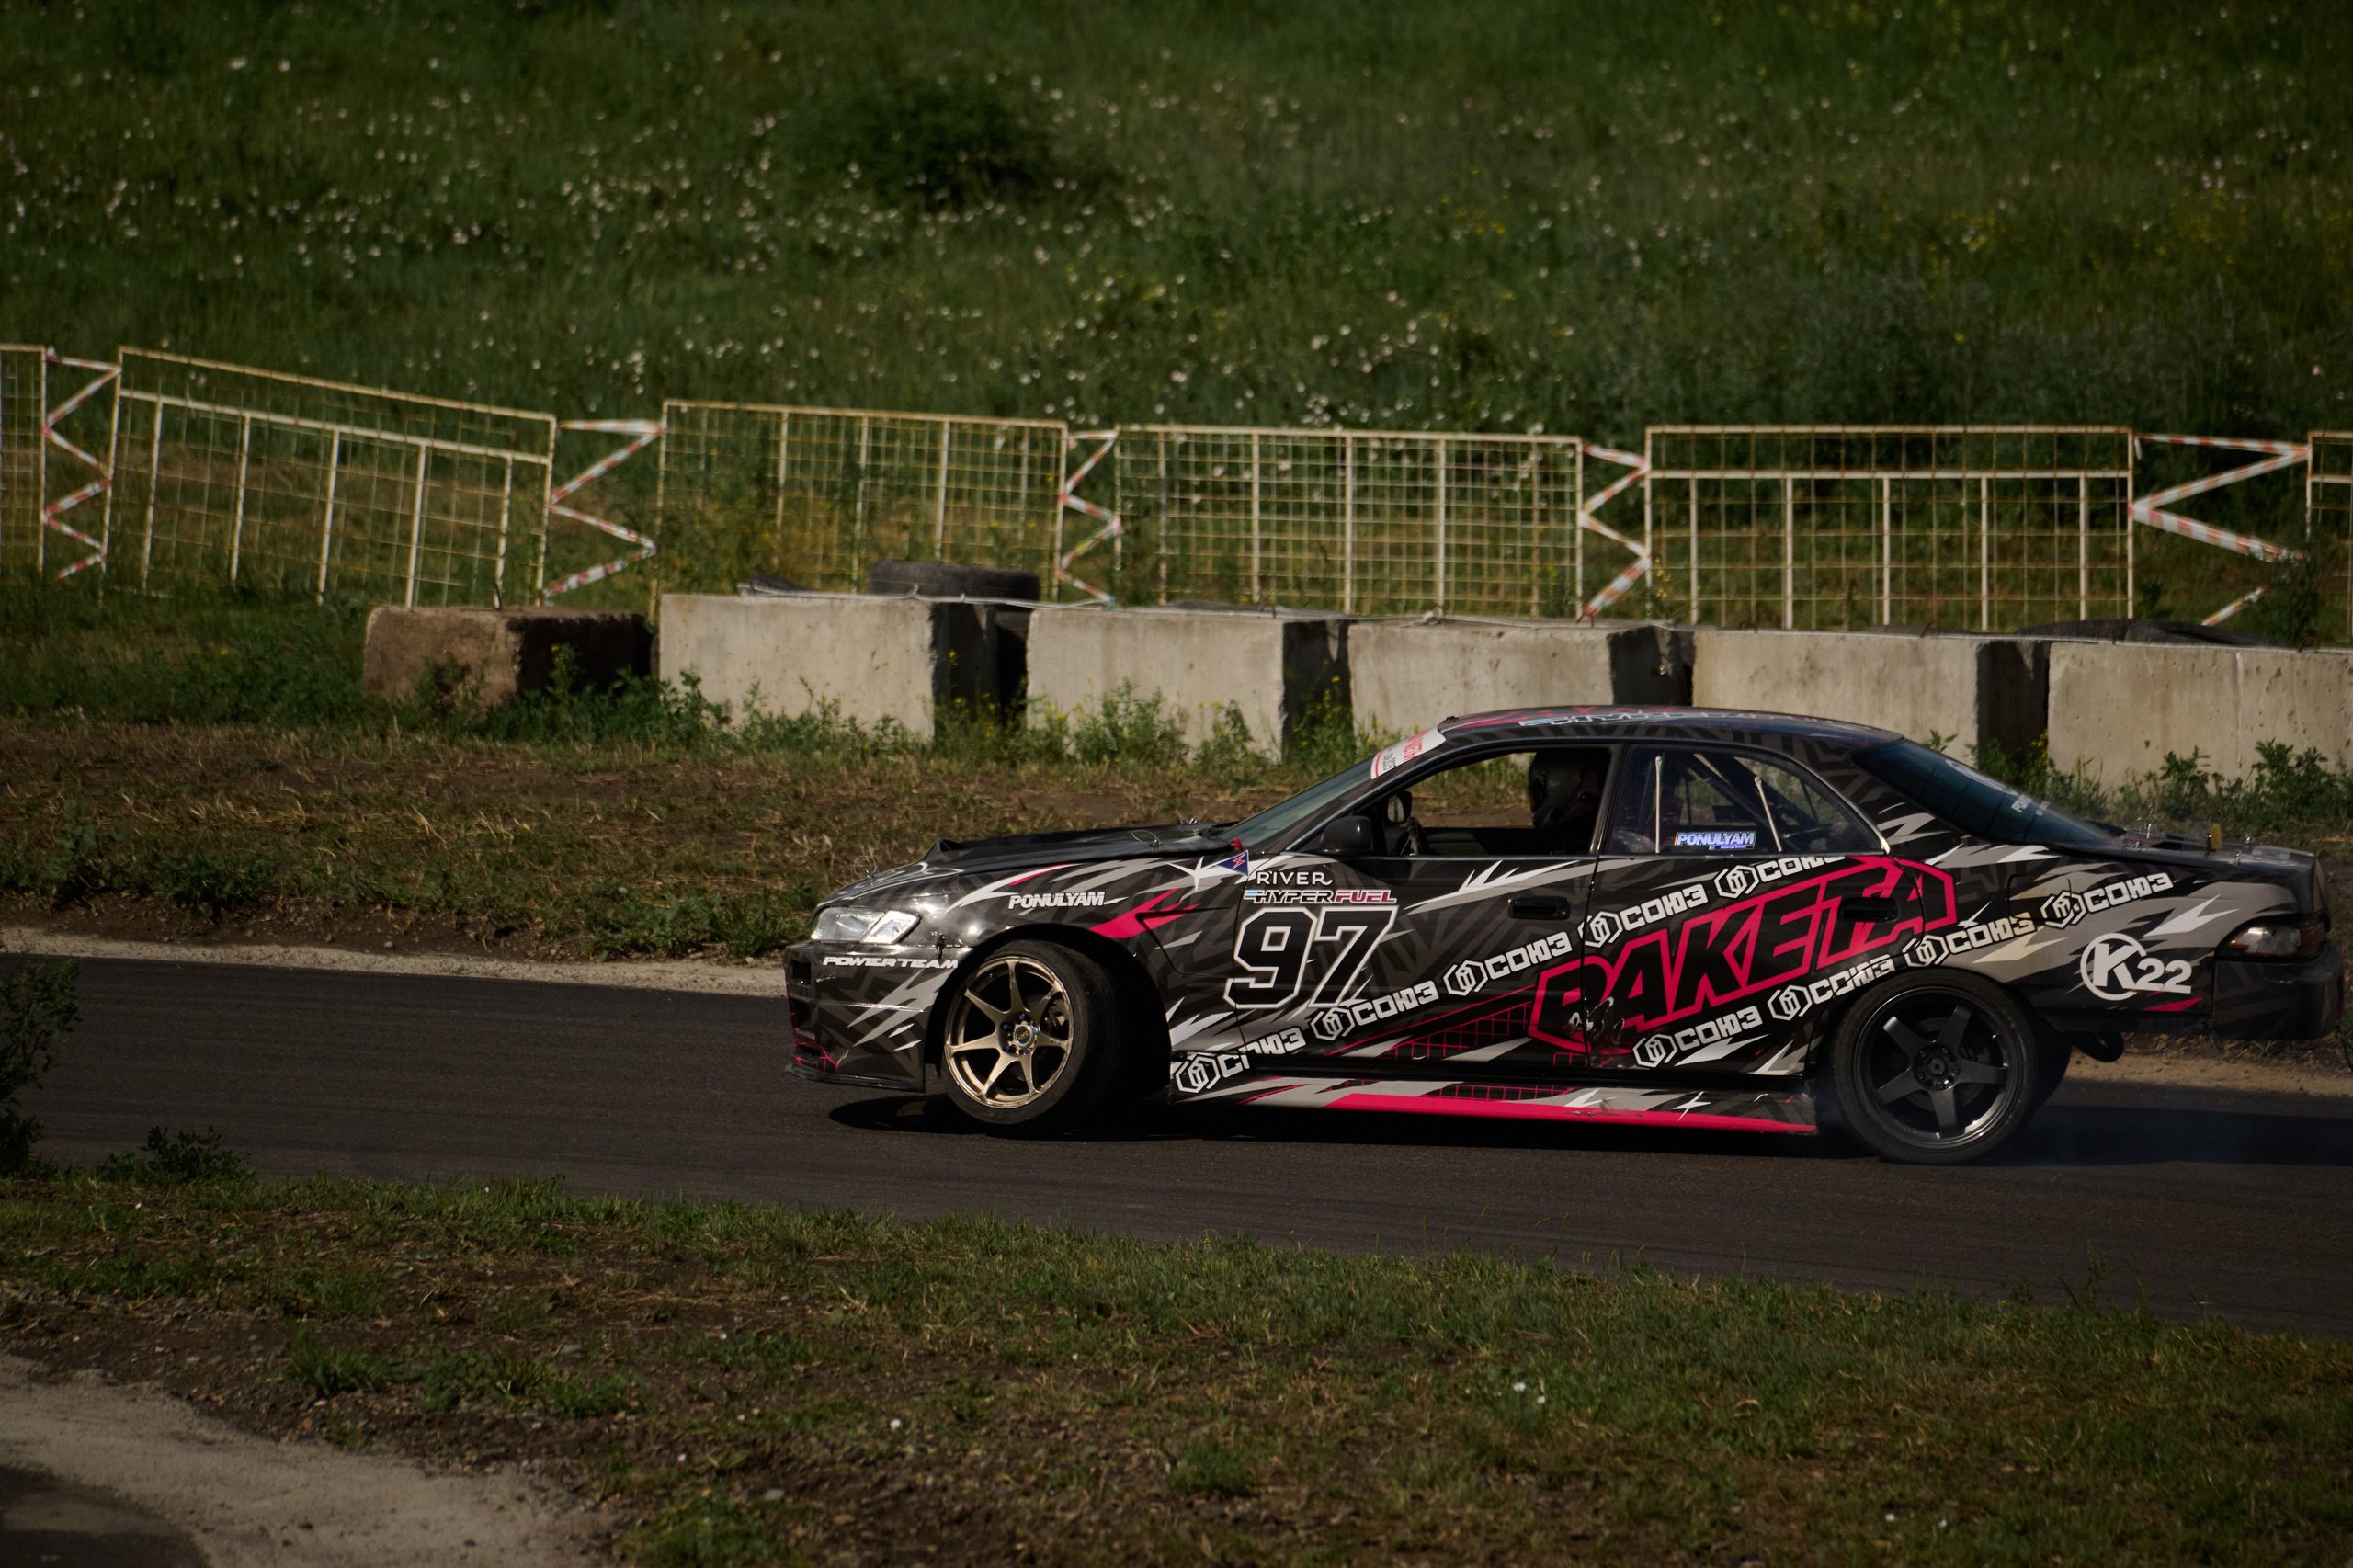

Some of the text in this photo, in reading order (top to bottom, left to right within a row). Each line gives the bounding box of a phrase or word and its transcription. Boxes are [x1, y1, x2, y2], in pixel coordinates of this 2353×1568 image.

[1676, 831, 1755, 846] PONULYAM
[1256, 871, 1333, 886] RIVER
[1008, 892, 1105, 909] PONULYAM
[823, 956, 959, 969] POWER TEAM
[1222, 905, 1399, 1010] 97
[1354, 980, 1439, 1022] СОЮЗ
[1484, 931, 1573, 979] СОЮЗ
[1622, 883, 1709, 930] СОЮЗ
[1677, 872, 2174, 1051] СОЮЗ СОЮЗ СОЮЗ СОЮЗ
[2083, 936, 2191, 998] K22
